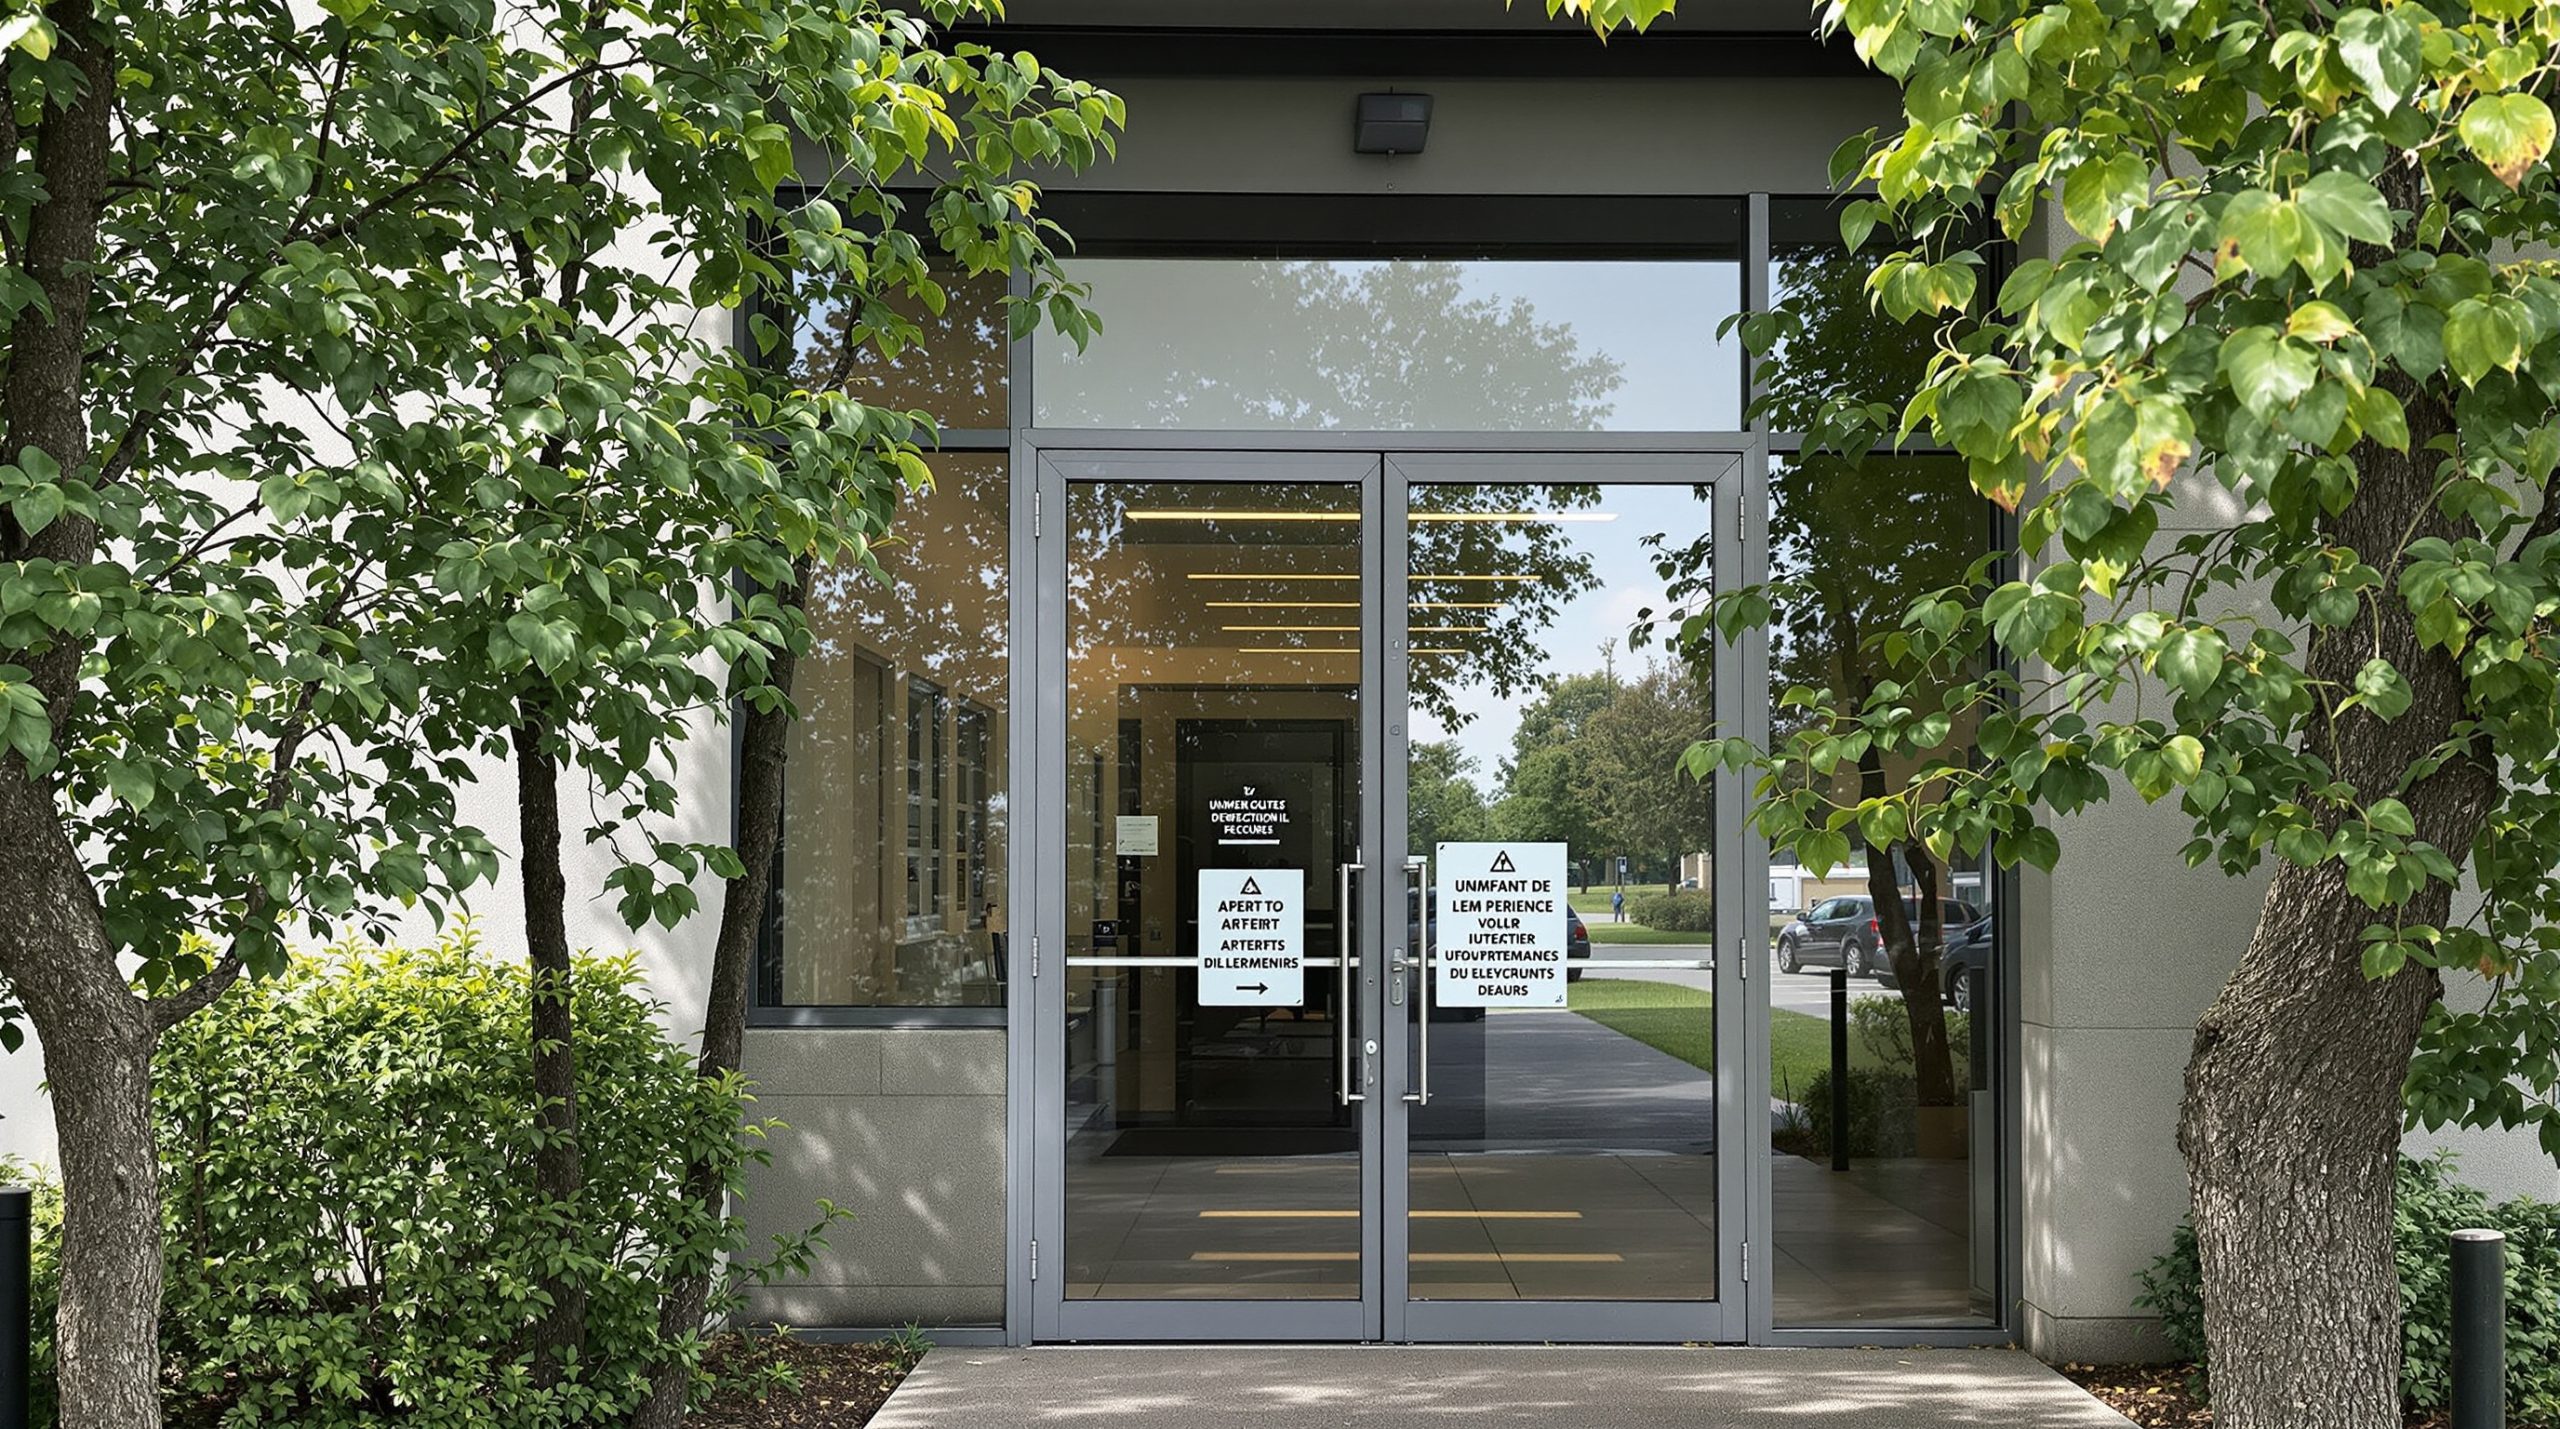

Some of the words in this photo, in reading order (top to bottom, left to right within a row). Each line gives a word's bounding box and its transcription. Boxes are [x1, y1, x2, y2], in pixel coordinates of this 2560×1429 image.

[1455, 879, 1528, 893] UNMFANT
[1531, 879, 1551, 893] DE
[1218, 900, 1263, 912] APERT
[1265, 900, 1284, 912] TO
[1452, 900, 1482, 913] LEM
[1485, 900, 1553, 913] PERIENCE
[1450, 967, 1468, 980] DU
[1478, 984, 1529, 996] DEAURS
